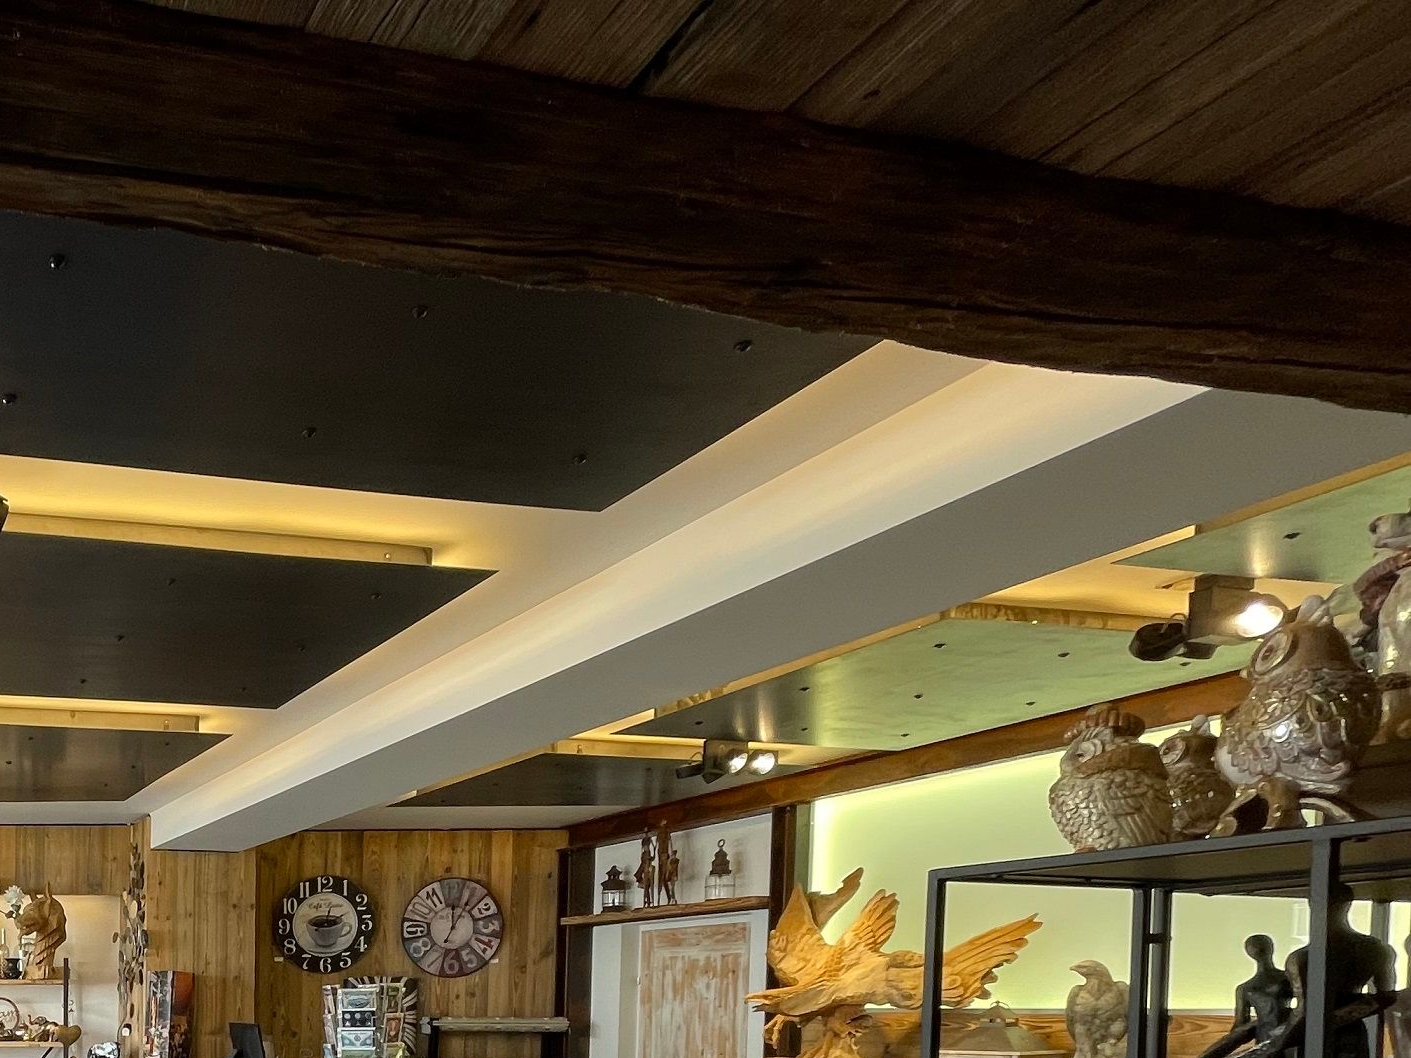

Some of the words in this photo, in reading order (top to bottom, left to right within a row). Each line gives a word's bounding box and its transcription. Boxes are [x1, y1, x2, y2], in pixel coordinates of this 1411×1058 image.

[299, 882, 309, 898] 11
[317, 876, 333, 892] 12
[343, 880, 348, 896] 1
[283, 897, 297, 914] 10
[355, 894, 368, 910] 2
[425, 887, 442, 908] 11
[410, 901, 431, 919] 10
[477, 902, 491, 915] 2
[278, 918, 290, 935] 9
[361, 914, 373, 931] 3
[405, 923, 426, 935] 9
[477, 919, 500, 934] 3
[283, 938, 296, 955] 8
[354, 936, 368, 952] 4
[410, 937, 431, 957] 8
[474, 936, 494, 955] 4
[301, 953, 311, 970] 7
[319, 957, 332, 973] 6
[339, 951, 352, 968] 5
[443, 951, 460, 974] 6
[460, 949, 478, 968] 5
